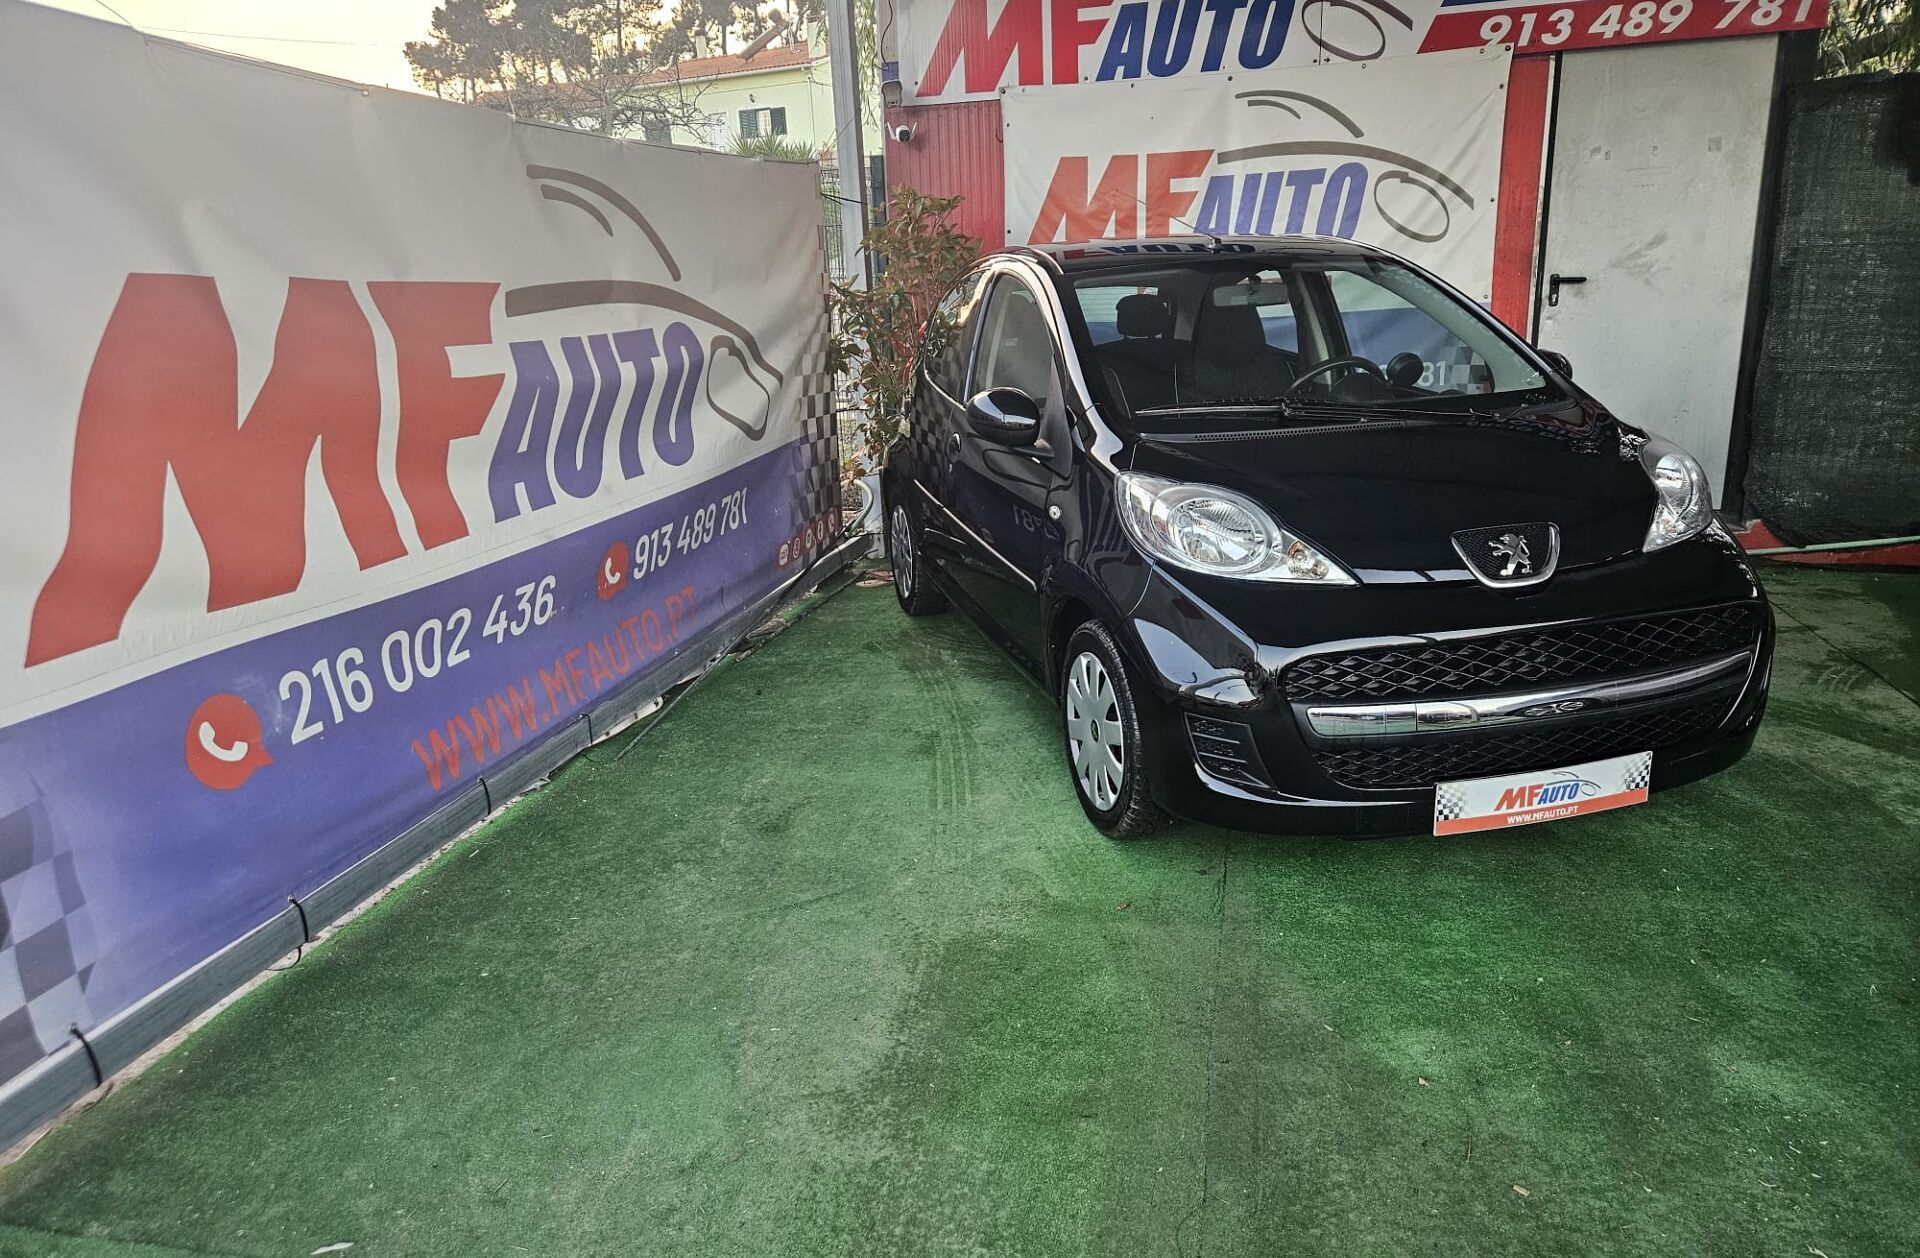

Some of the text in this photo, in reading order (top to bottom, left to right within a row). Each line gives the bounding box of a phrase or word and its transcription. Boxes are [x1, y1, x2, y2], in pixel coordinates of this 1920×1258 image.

[1479, 9, 1576, 47] 913
[1588, 0, 1692, 39] 489
[633, 488, 748, 579] 913 489 781
[279, 574, 556, 745] 216 002 436
[411, 586, 697, 792] WWW.MFAUTO.PT
[1508, 805, 1579, 824] WWW.MFAUTO.PT
